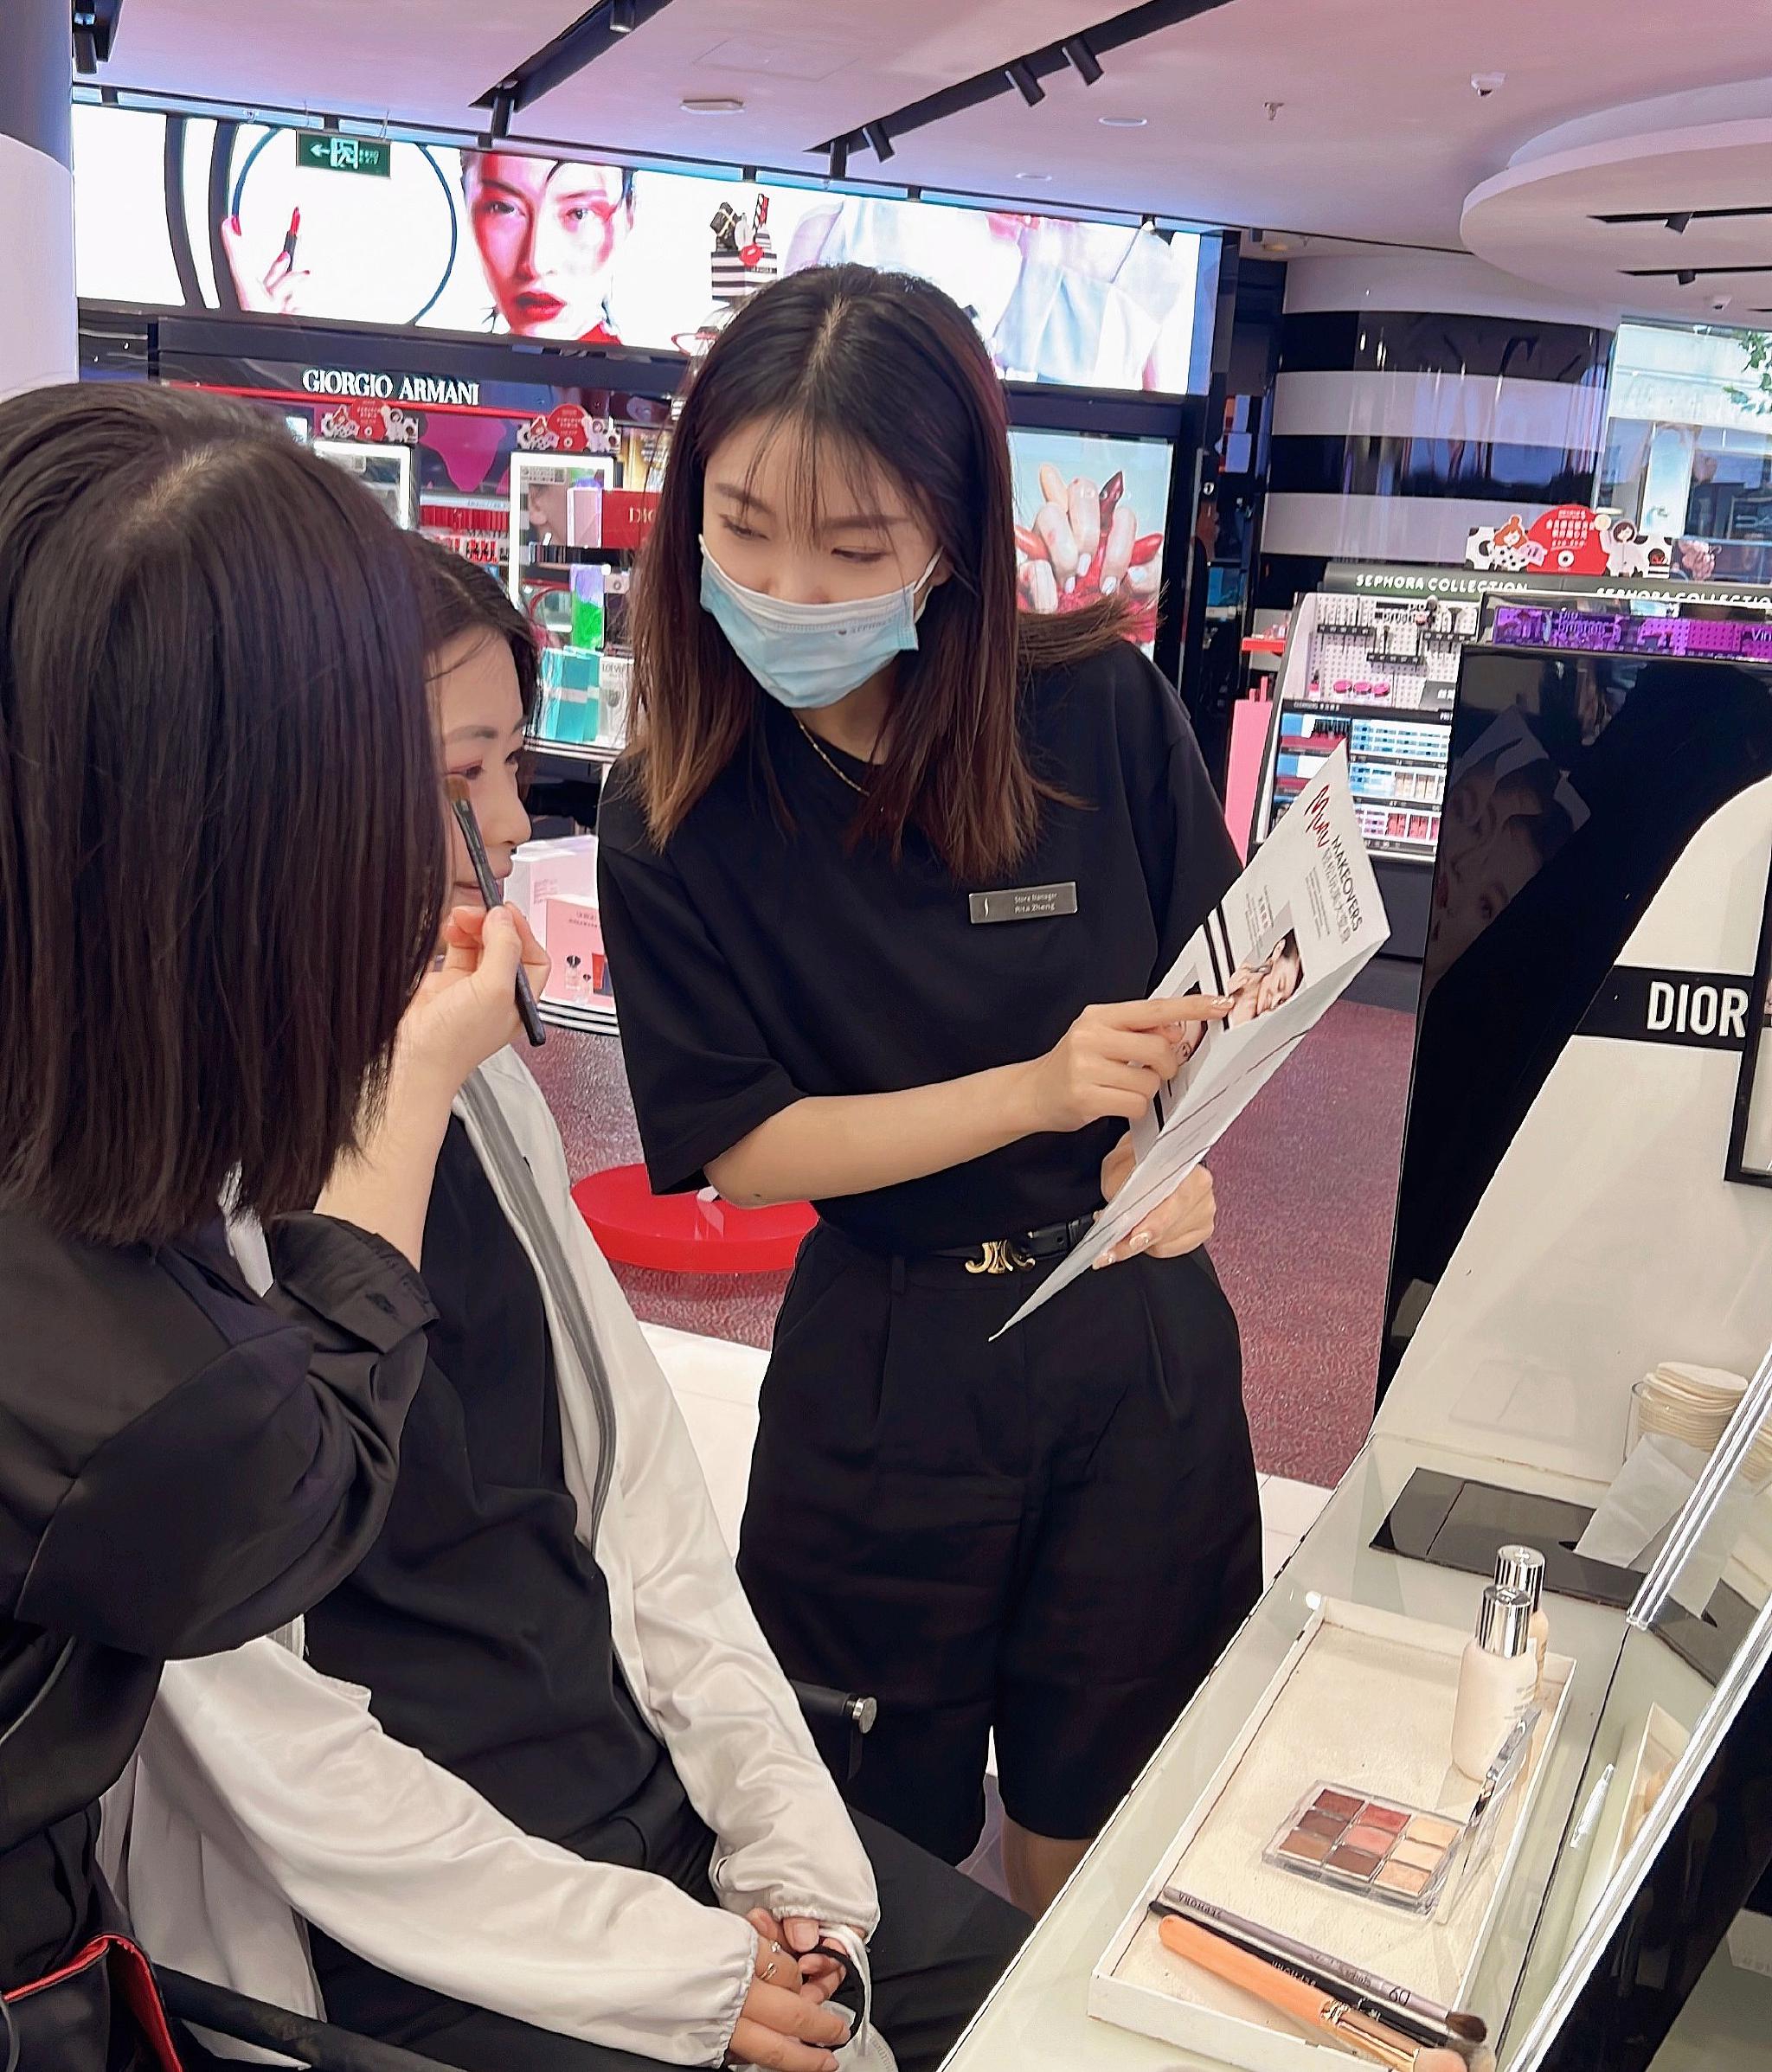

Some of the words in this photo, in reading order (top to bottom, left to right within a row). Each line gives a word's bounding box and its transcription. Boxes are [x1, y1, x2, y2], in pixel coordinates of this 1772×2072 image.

[303, 369, 394, 398] GIORGIO
[399, 376, 479, 405] ARMANI
[1356, 574, 1424, 591] SEPHORA
[1332, 834, 1363, 932] MAKEOVERS
[1014, 895, 1030, 904] Store
[1014, 905, 1030, 914] Rita
[1647, 980, 1749, 1038] DIOR
